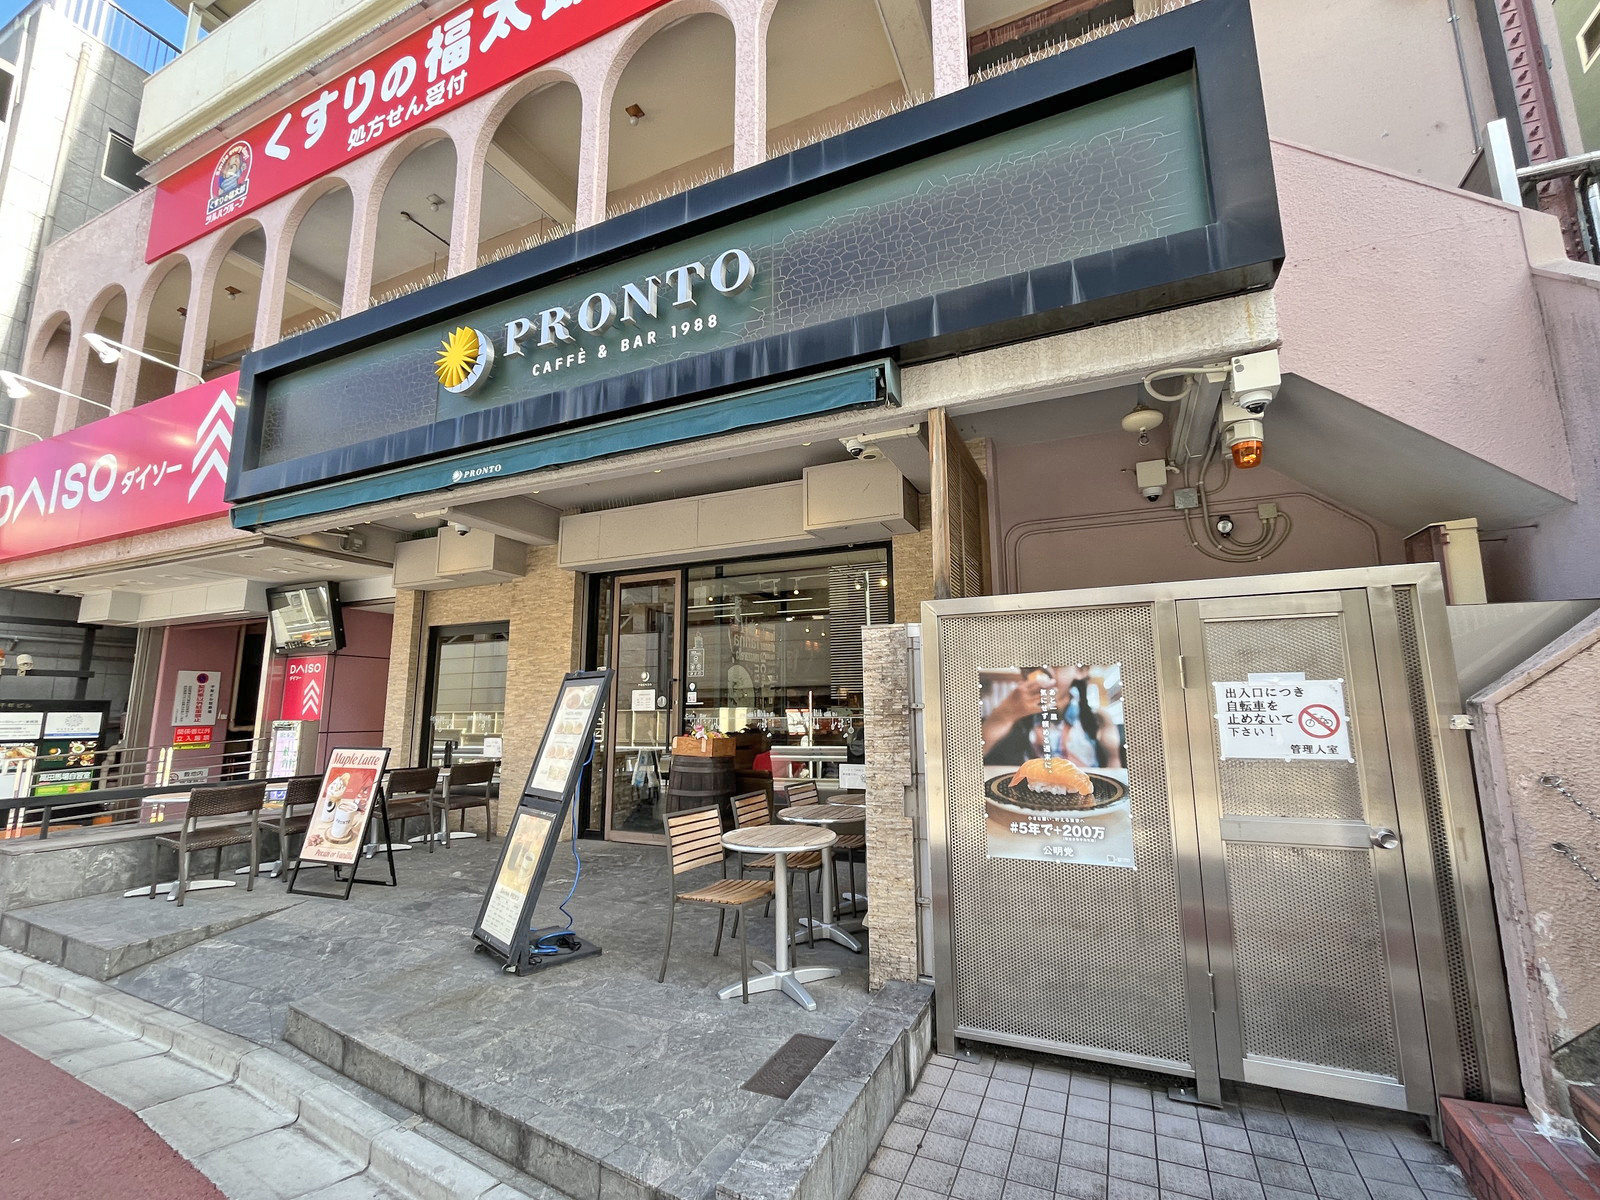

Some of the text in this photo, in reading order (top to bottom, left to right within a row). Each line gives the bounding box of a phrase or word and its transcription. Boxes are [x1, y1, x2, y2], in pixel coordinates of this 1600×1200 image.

[347, 71, 467, 152] 処方せん受付
[503, 248, 755, 359] PRONTO
[532, 314, 718, 376] CAFFÈ & BAR 1988
[121, 460, 183, 494] ダイソー
[463, 464, 502, 479] PRONTO
[289, 663, 321, 675] DAISO
[1225, 687, 1304, 699] 出入口につき
[1049, 688, 1058, 721] あと一皿
[1226, 701, 1278, 712] 自転車を
[1290, 744, 1339, 755] 管理人室
[334, 752, 380, 767] Maple Latte
[1043, 845, 1075, 857] 公明党
